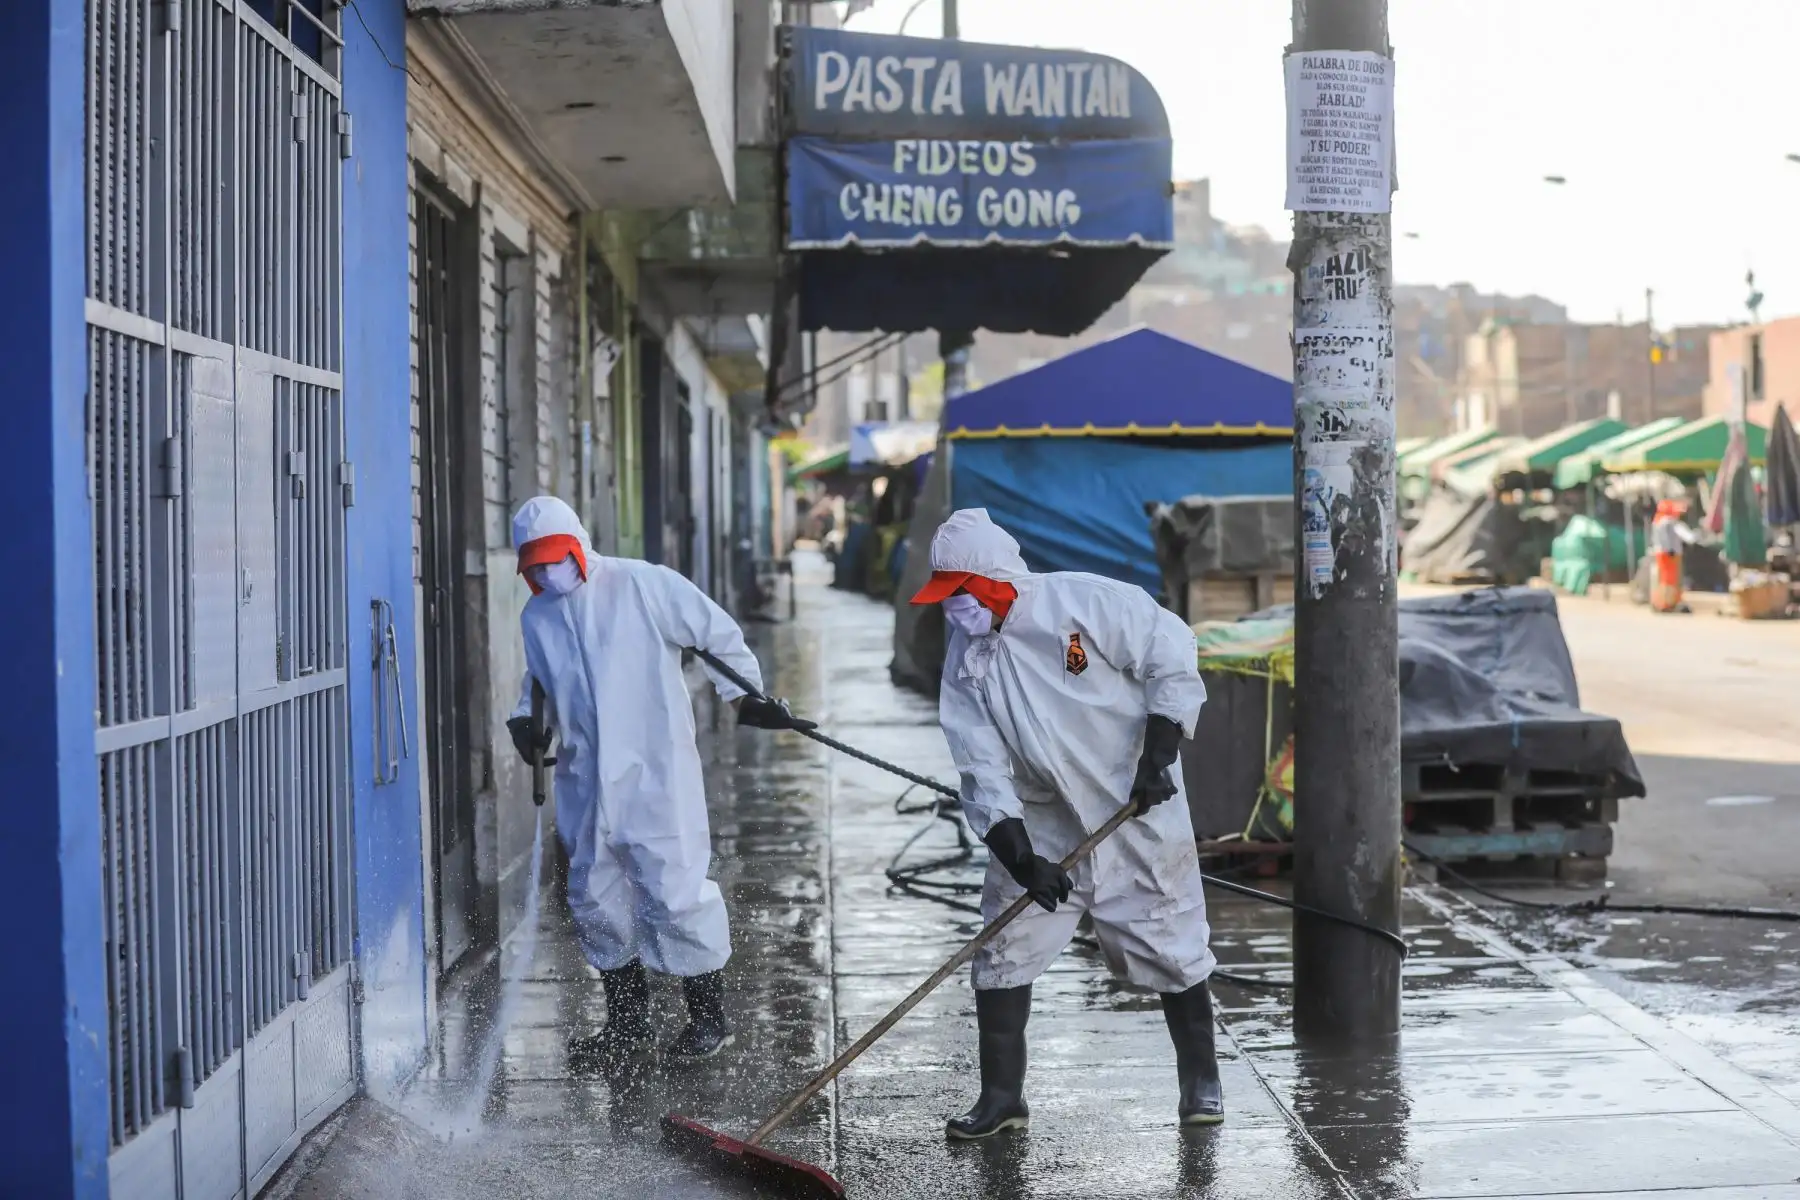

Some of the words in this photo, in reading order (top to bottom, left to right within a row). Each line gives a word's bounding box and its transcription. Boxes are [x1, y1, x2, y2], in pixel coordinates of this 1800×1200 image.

[814, 50, 964, 116] PASTA
[982, 60, 1132, 118] WANTAN
[1302, 56, 1345, 70] PALABRA
[1347, 58, 1361, 72] DE
[1362, 60, 1385, 75] DIOS
[893, 138, 1037, 177] FIDEOS
[1318, 140, 1330, 153] SU
[1333, 140, 1371, 156] PODER!
[838, 181, 964, 228] CHENG
[976, 186, 1082, 228] GONG
